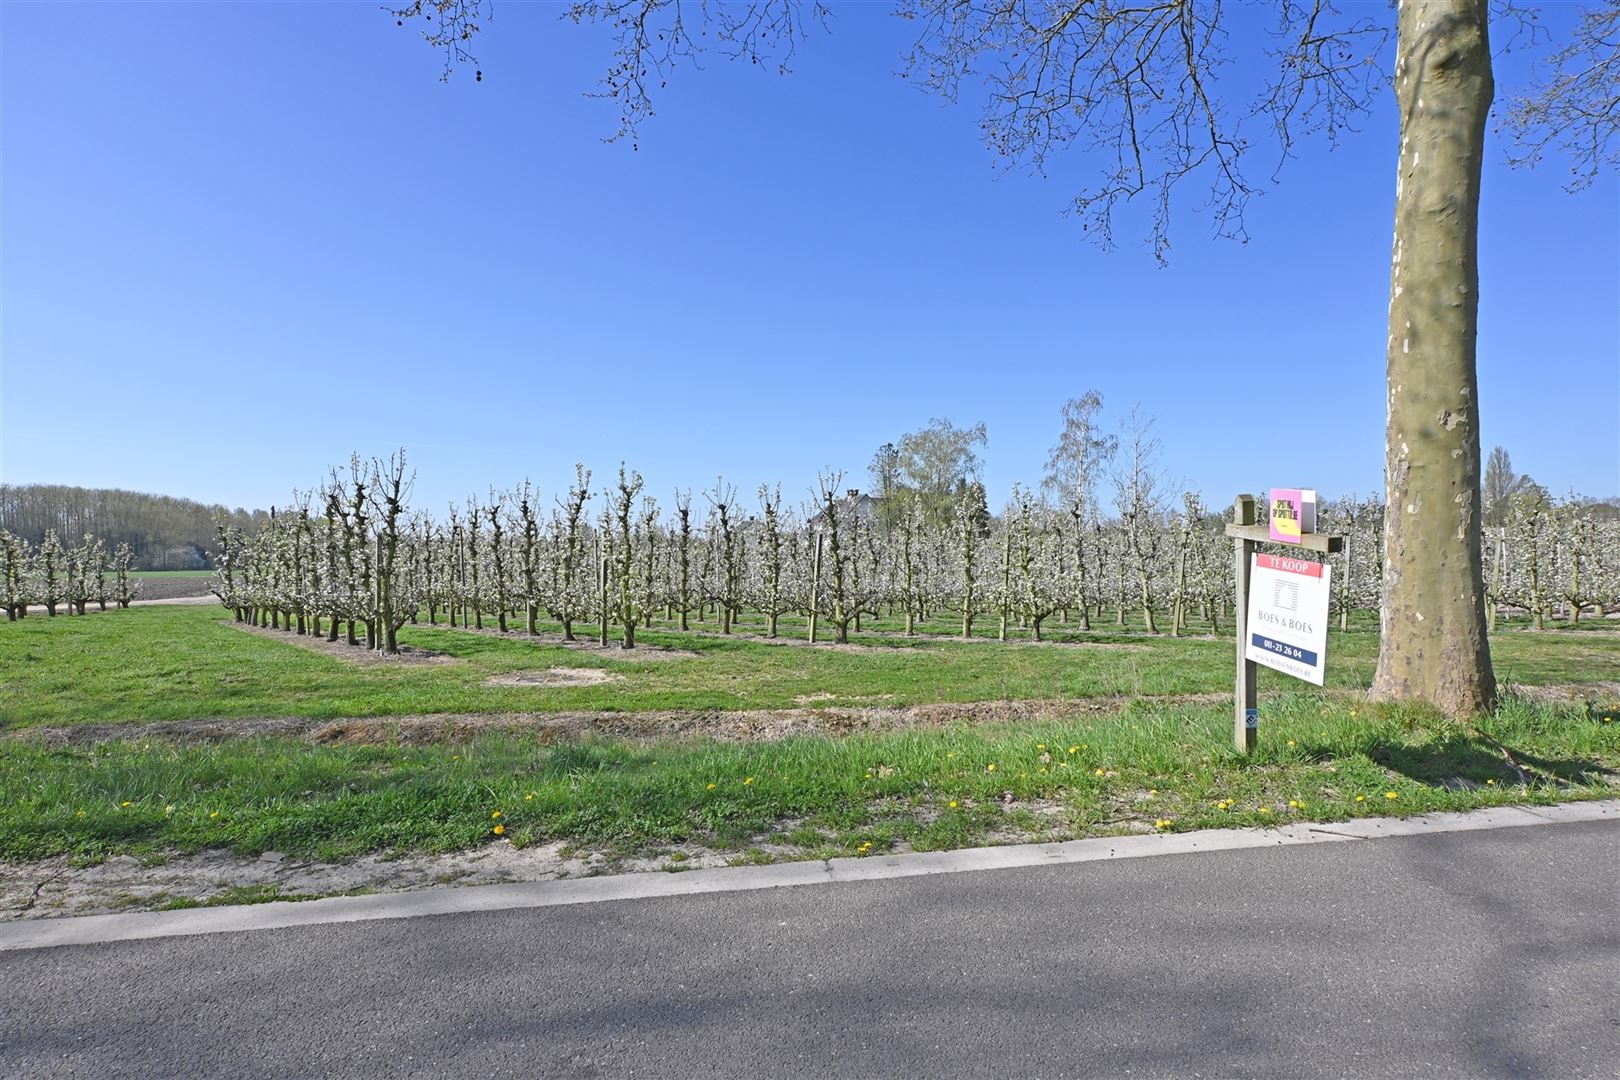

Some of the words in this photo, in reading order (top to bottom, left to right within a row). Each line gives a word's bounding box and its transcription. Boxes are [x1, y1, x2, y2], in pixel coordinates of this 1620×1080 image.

[1270, 557, 1280, 568] TE
[1283, 560, 1309, 573] KOOP
[1258, 610, 1279, 625] BOES
[1281, 617, 1287, 627] &
[1288, 618, 1313, 634] BOES
[1283, 645, 1292, 656] 26
[1293, 648, 1302, 659] 04
